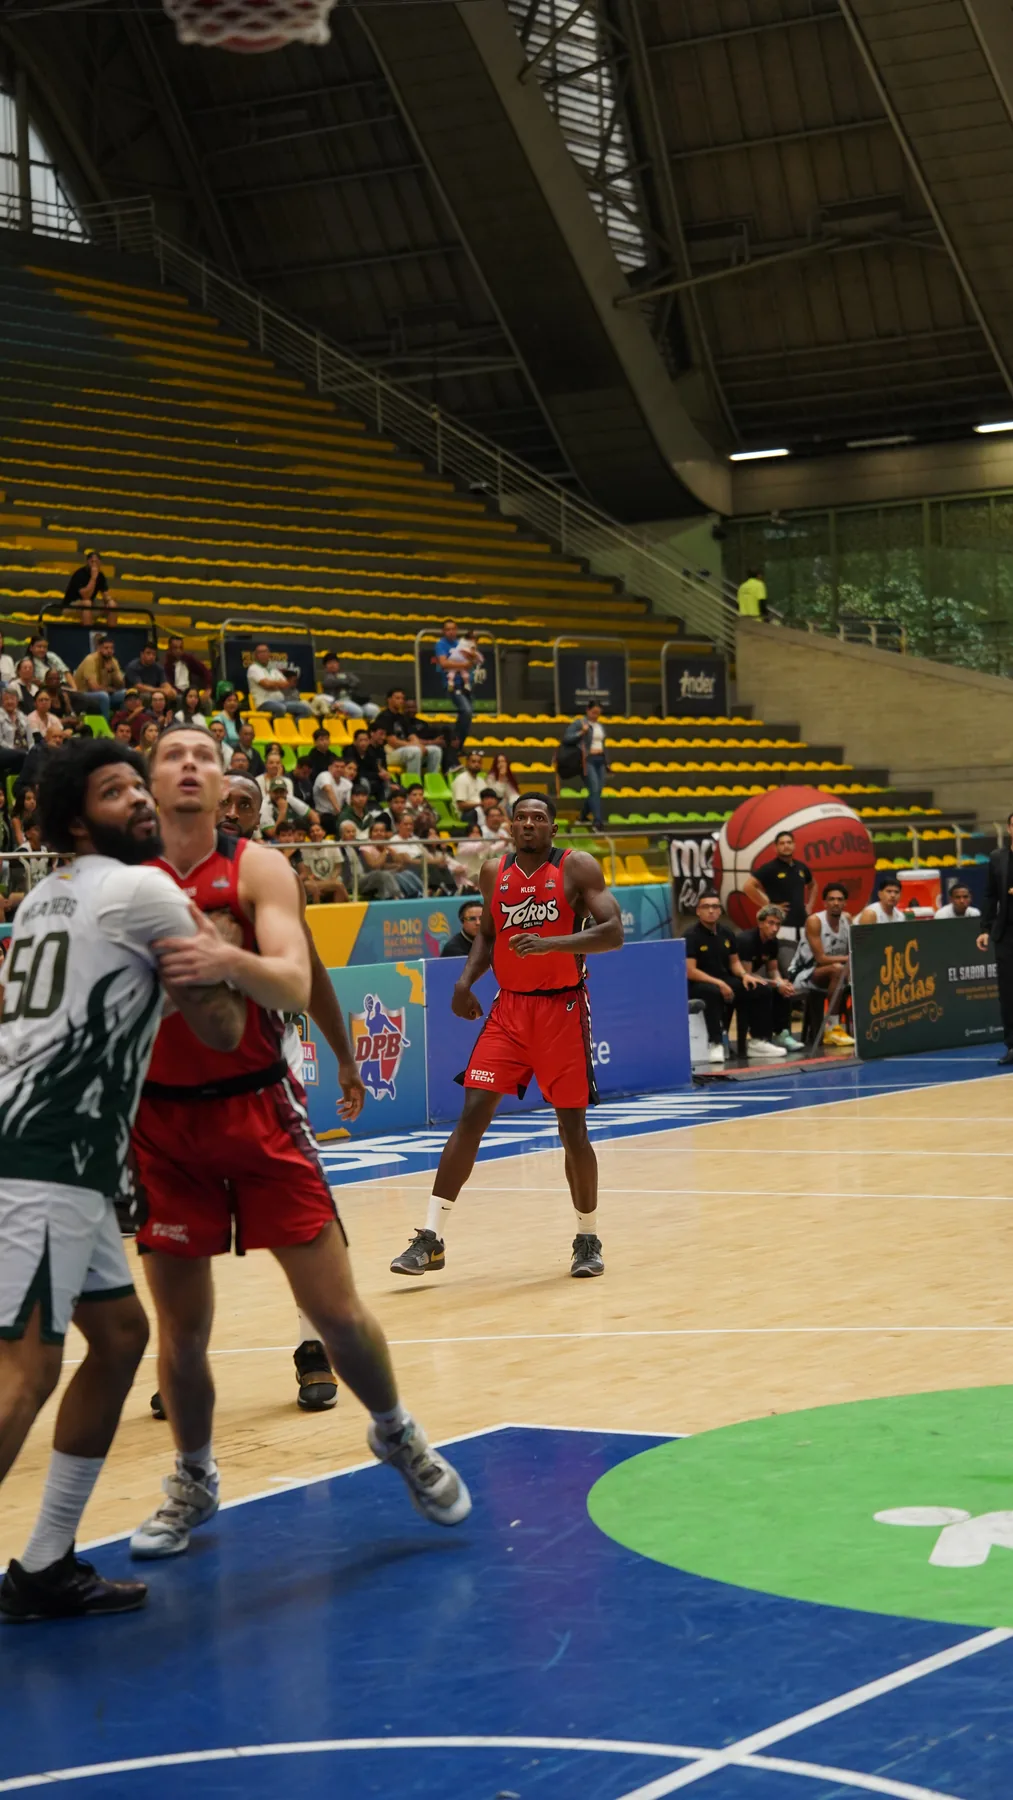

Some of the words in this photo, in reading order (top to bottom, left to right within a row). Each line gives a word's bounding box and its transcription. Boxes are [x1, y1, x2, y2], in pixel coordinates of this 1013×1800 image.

[520, 885, 536, 893] KLEOS
[499, 895, 560, 932] TOROS
[384, 918, 423, 936] RADIO
[880, 939, 920, 985] J&C
[948, 967, 958, 981] EL
[959, 964, 985, 980] SABOR
[2, 931, 70, 1023] 50
[869, 976, 936, 1015] delicias
[355, 1032, 402, 1062] DPB
[470, 1075, 494, 1084] TECH
[471, 1069, 495, 1078] BODY
